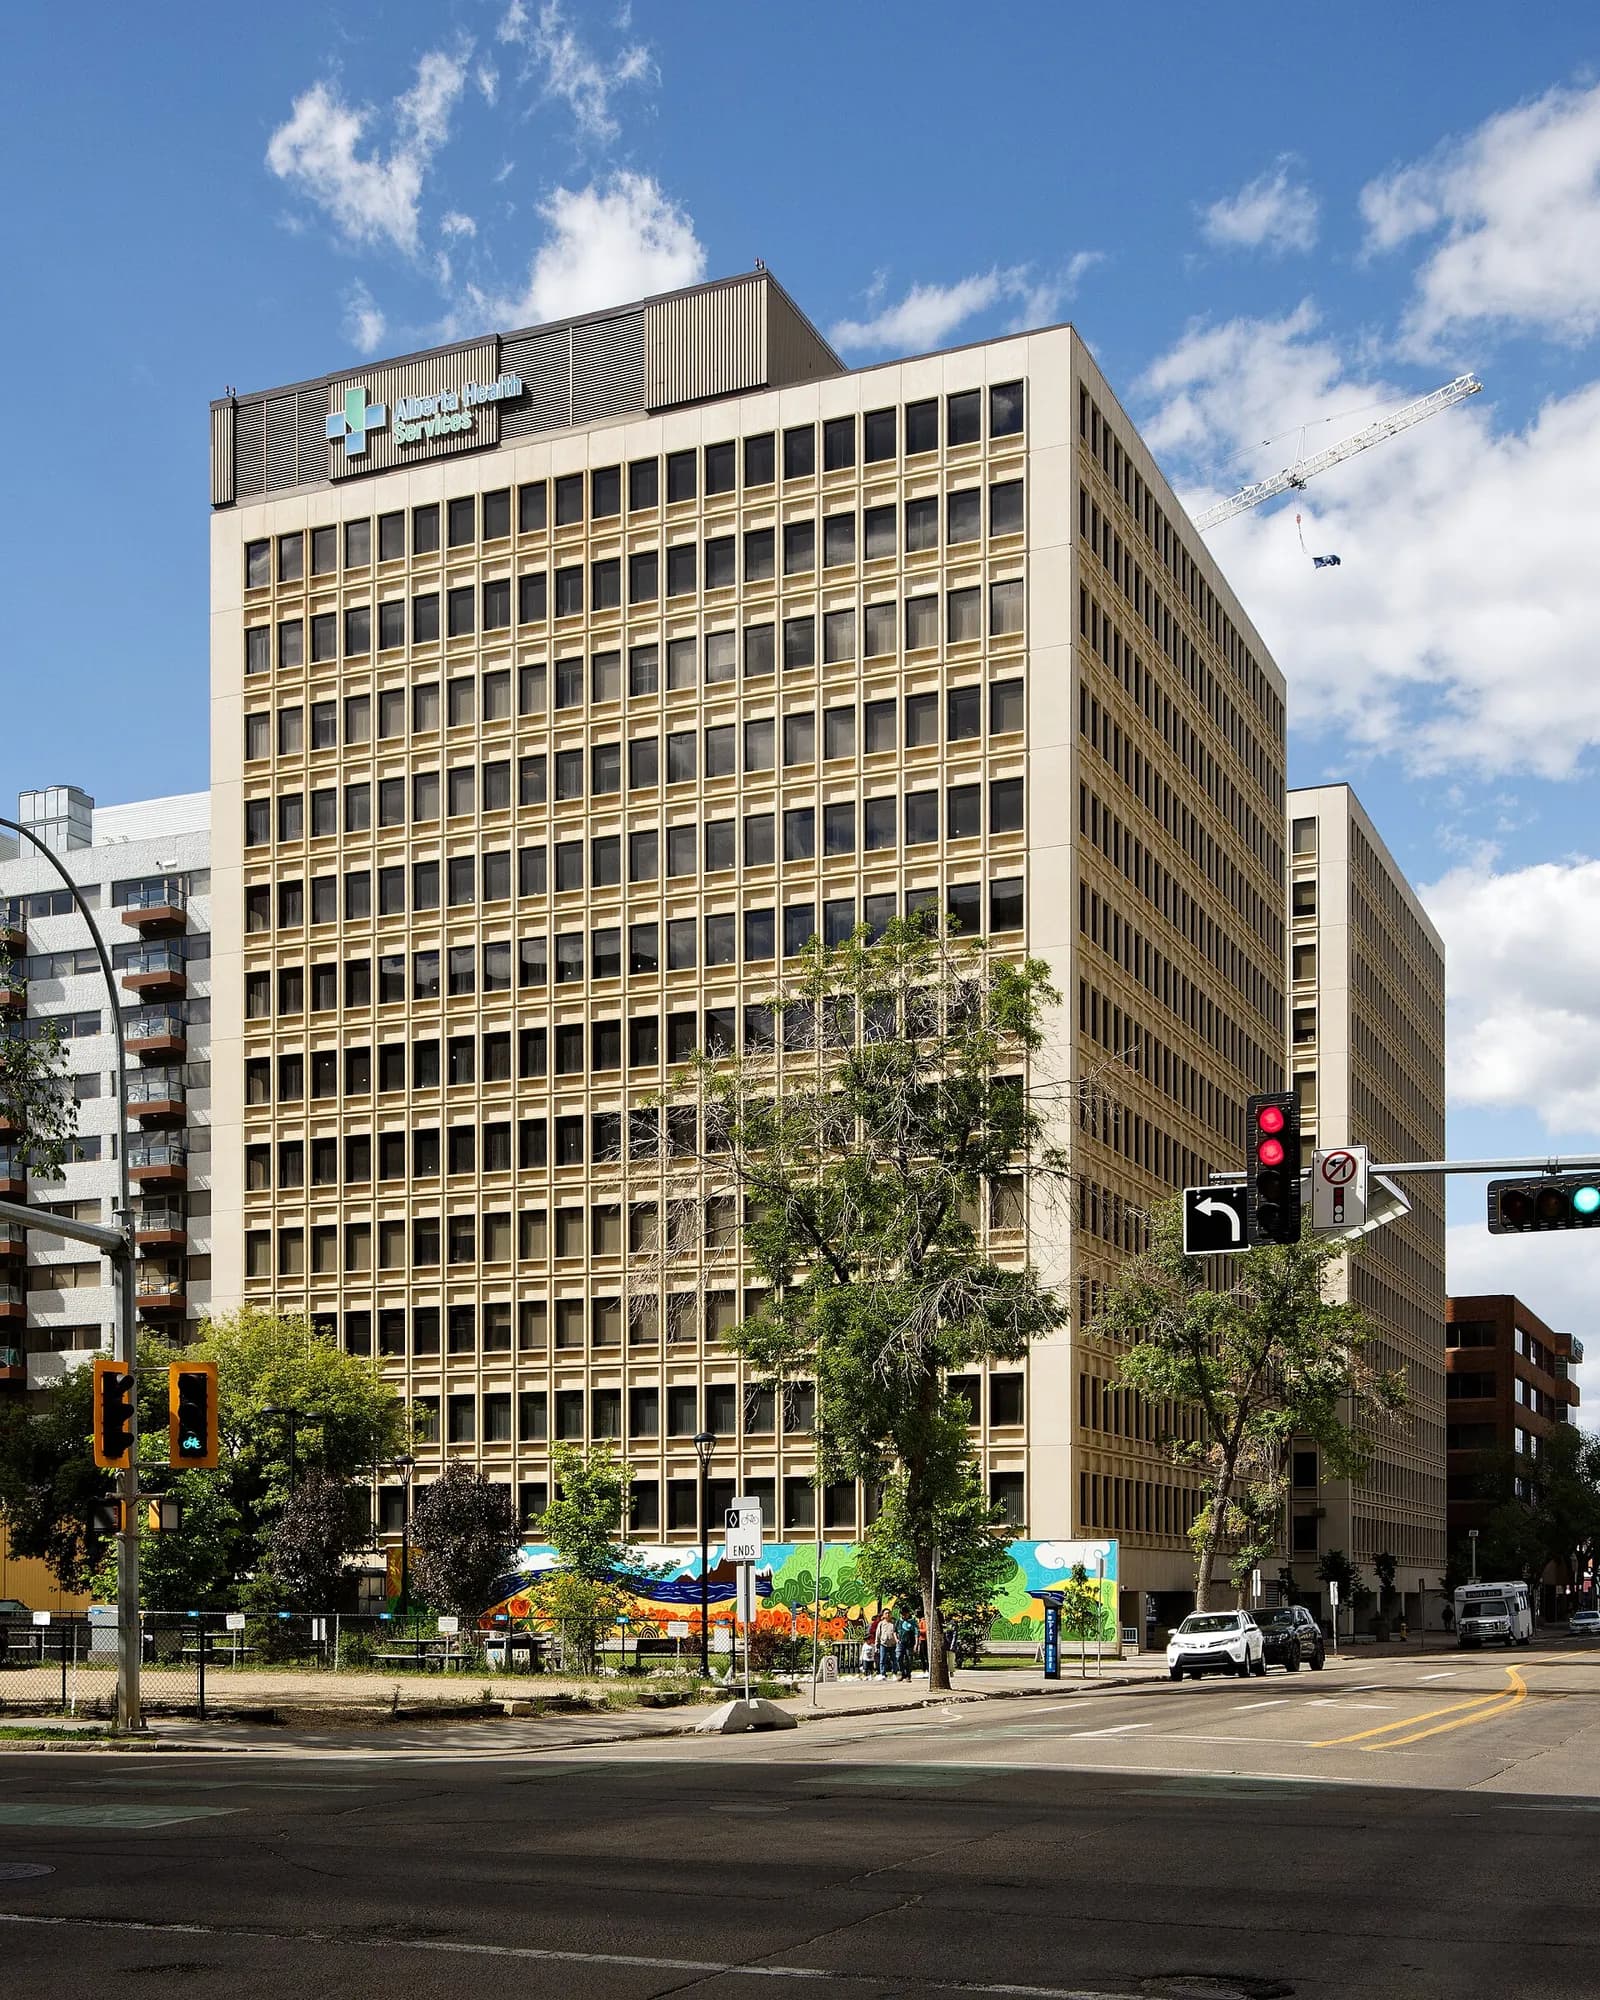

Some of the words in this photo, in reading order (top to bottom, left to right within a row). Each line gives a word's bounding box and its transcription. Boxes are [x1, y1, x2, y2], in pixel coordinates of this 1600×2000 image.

[394, 390, 458, 421] Alberta
[462, 373, 523, 406] Health
[393, 411, 473, 445] Services
[733, 1545, 755, 1557] ENDS
